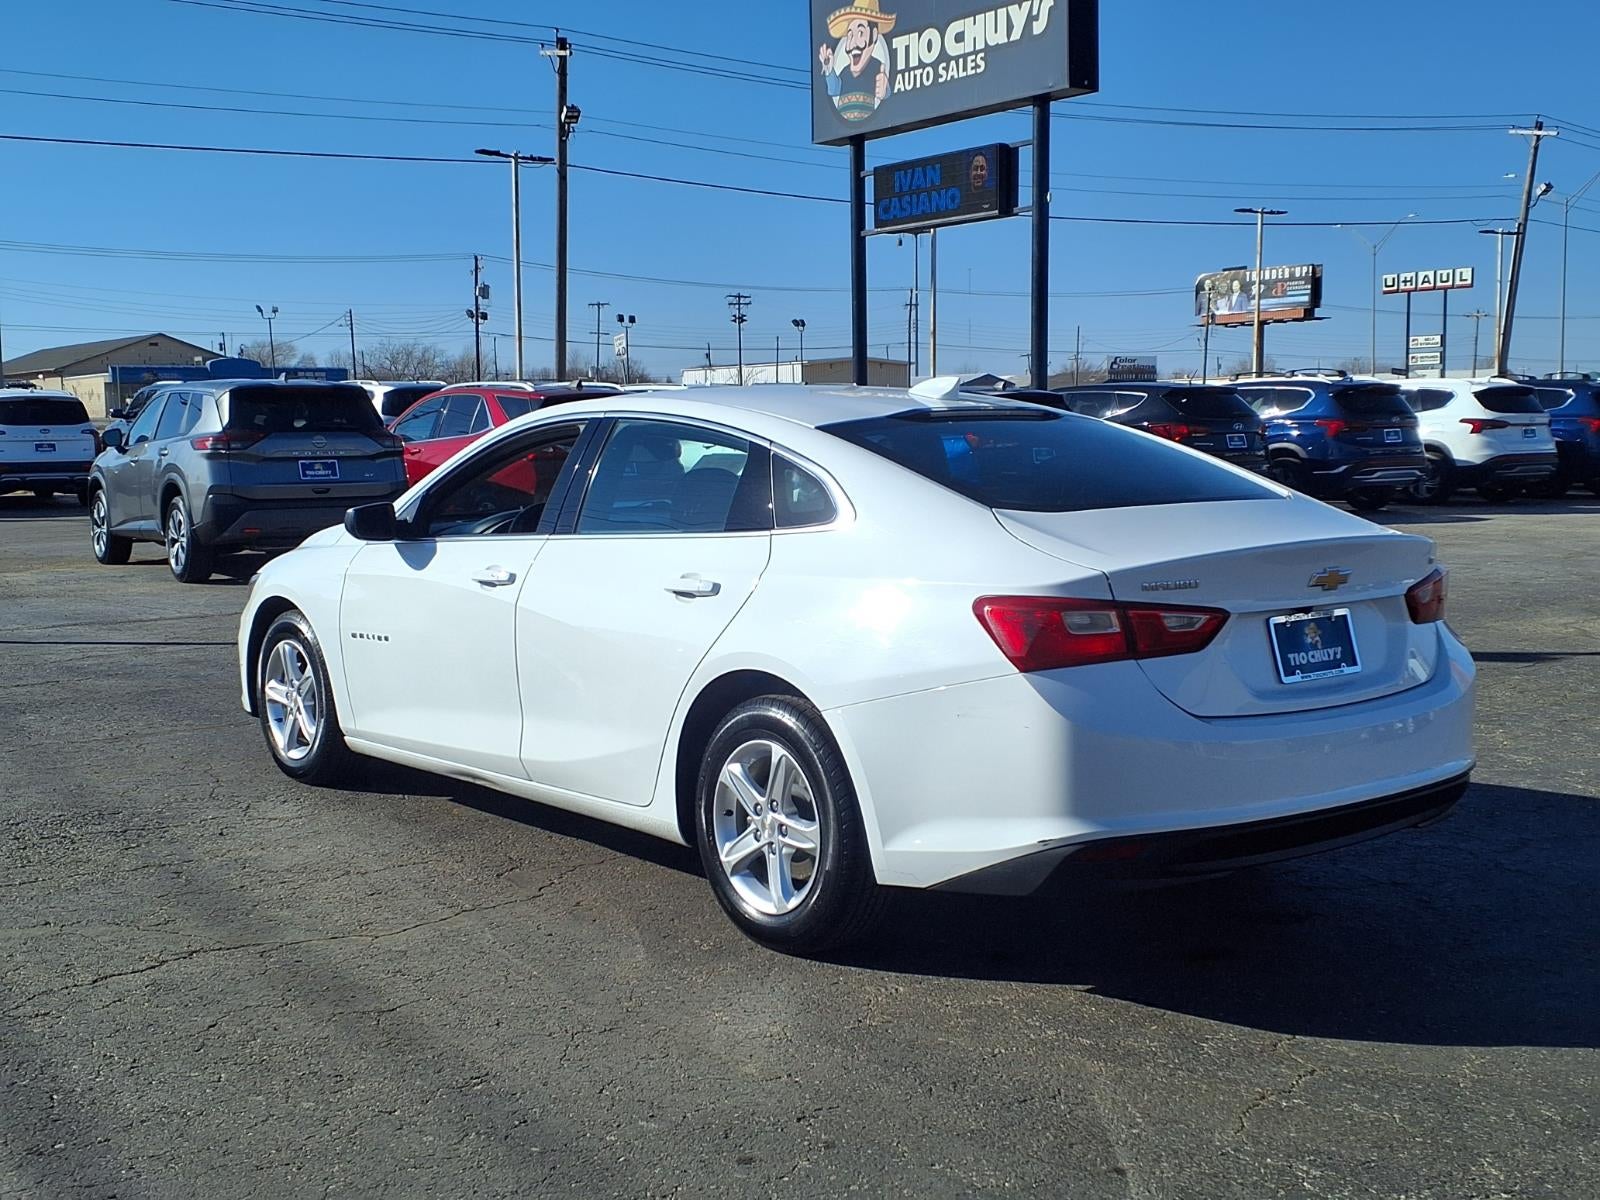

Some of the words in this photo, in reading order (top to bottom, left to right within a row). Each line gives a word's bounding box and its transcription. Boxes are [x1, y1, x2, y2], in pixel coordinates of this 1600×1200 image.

[892, 28, 942, 70] TIO
[944, 0, 1055, 57] CHUY'S
[893, 65, 934, 94] AUTO
[938, 52, 986, 83] SALES
[894, 163, 942, 193] IVAN
[878, 187, 961, 221] CASIANO
[1295, 265, 1313, 278] UP!
[1114, 356, 1137, 364] Color
[1141, 579, 1200, 592] MALIBU
[1287, 651, 1308, 666] TIO
[1308, 646, 1342, 663] CHUY'S
